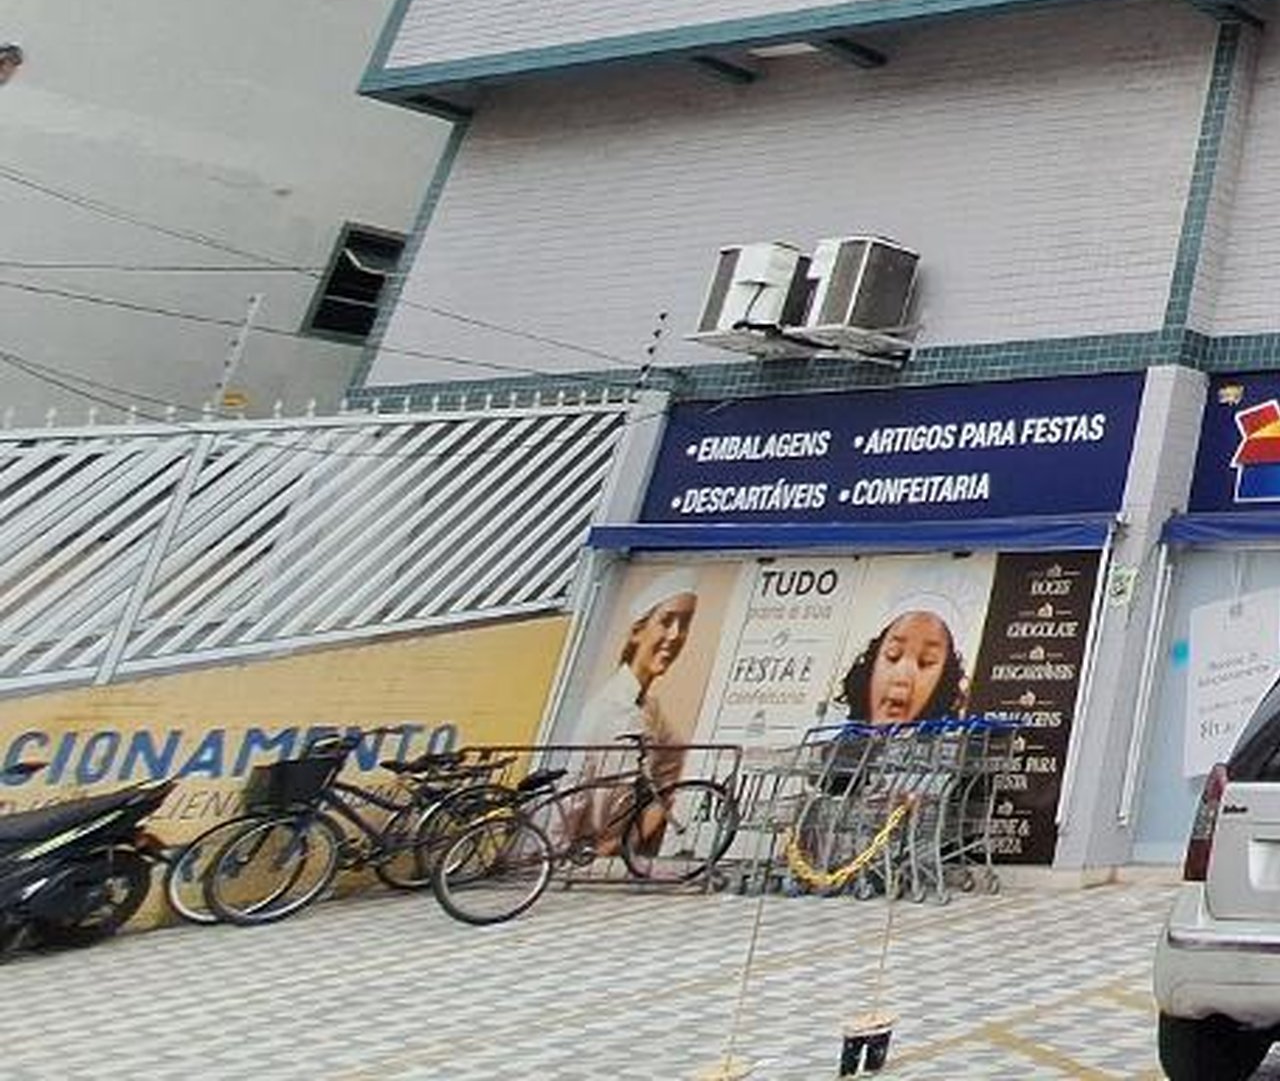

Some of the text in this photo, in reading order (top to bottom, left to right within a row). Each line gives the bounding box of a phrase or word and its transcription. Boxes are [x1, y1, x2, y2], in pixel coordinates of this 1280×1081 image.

[697, 414, 1106, 462] EMBALAGENS ARTIGOS PARA FESTAS
[680, 473, 990, 514] DESCARTÁVEIS CONFEITARIA
[760, 568, 839, 598] TUDO
[733, 655, 796, 684] FESTA
